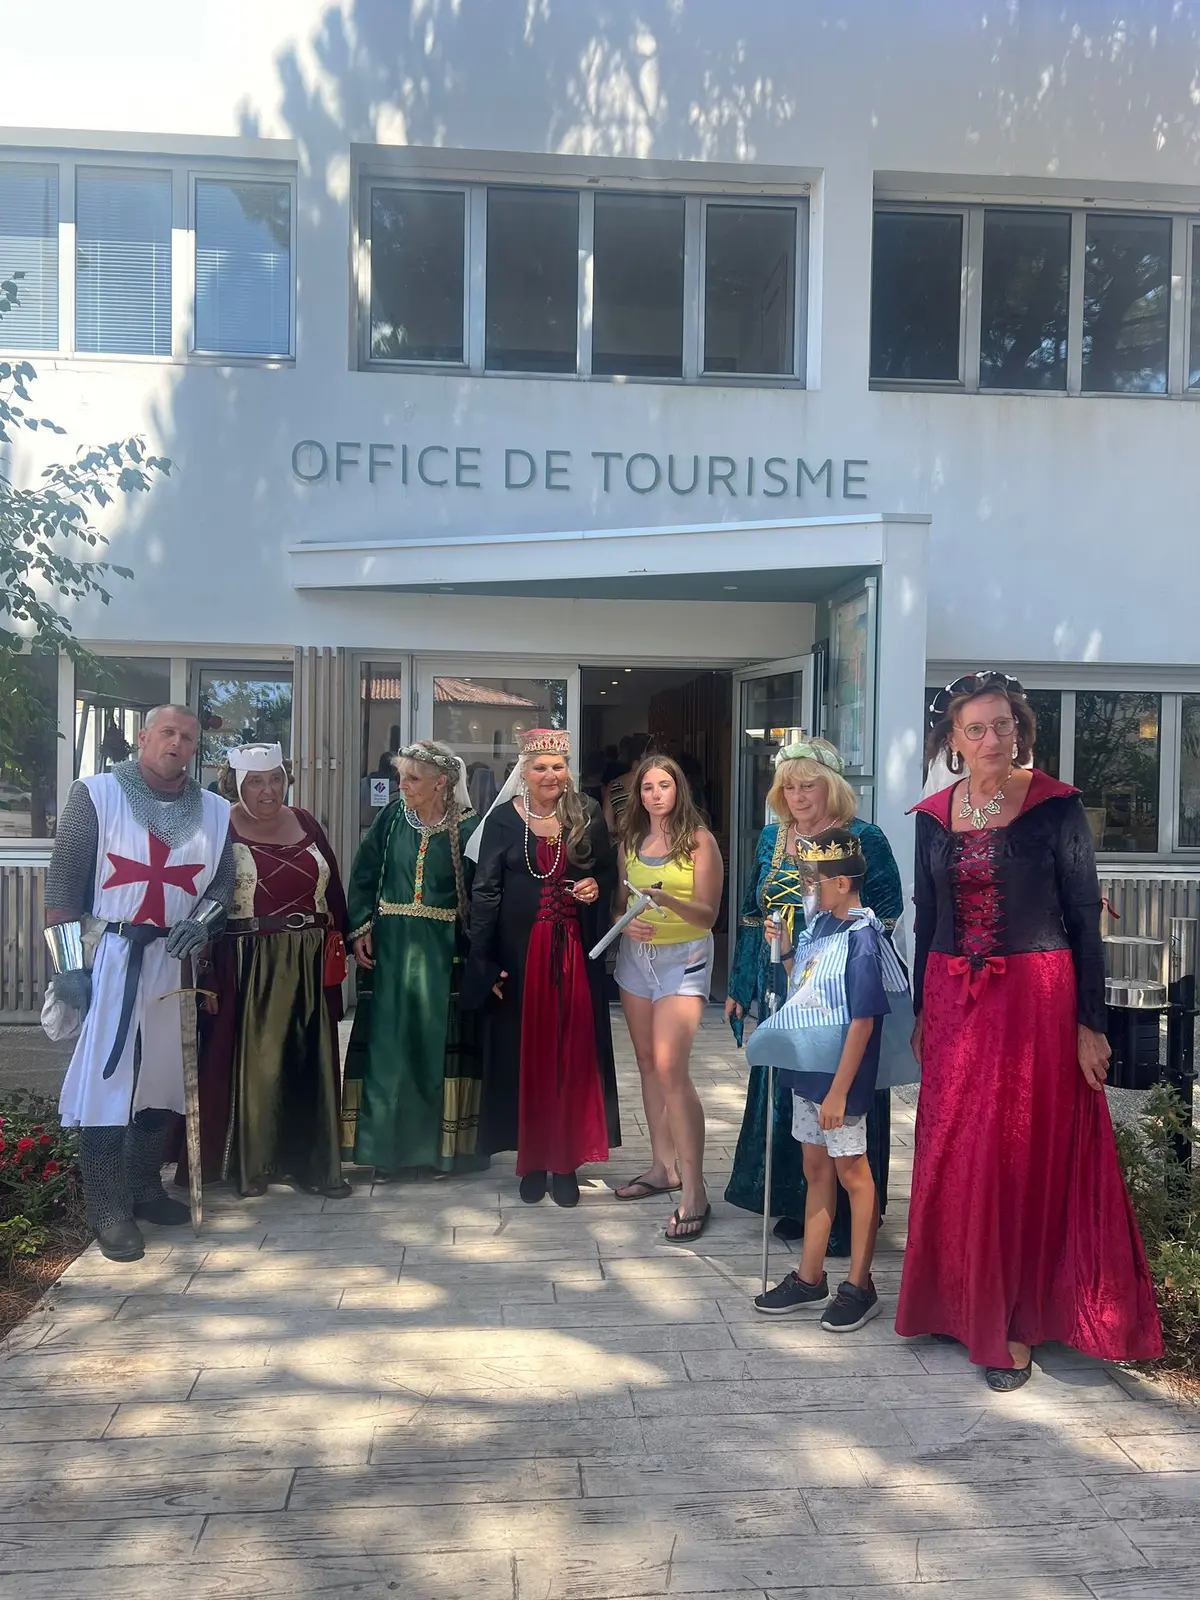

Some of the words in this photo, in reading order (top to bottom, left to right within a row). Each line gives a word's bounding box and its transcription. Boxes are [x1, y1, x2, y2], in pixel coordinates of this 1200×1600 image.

[292, 440, 481, 488] OFFICE
[504, 448, 571, 491] DE
[591, 451, 868, 499] TOURISME
